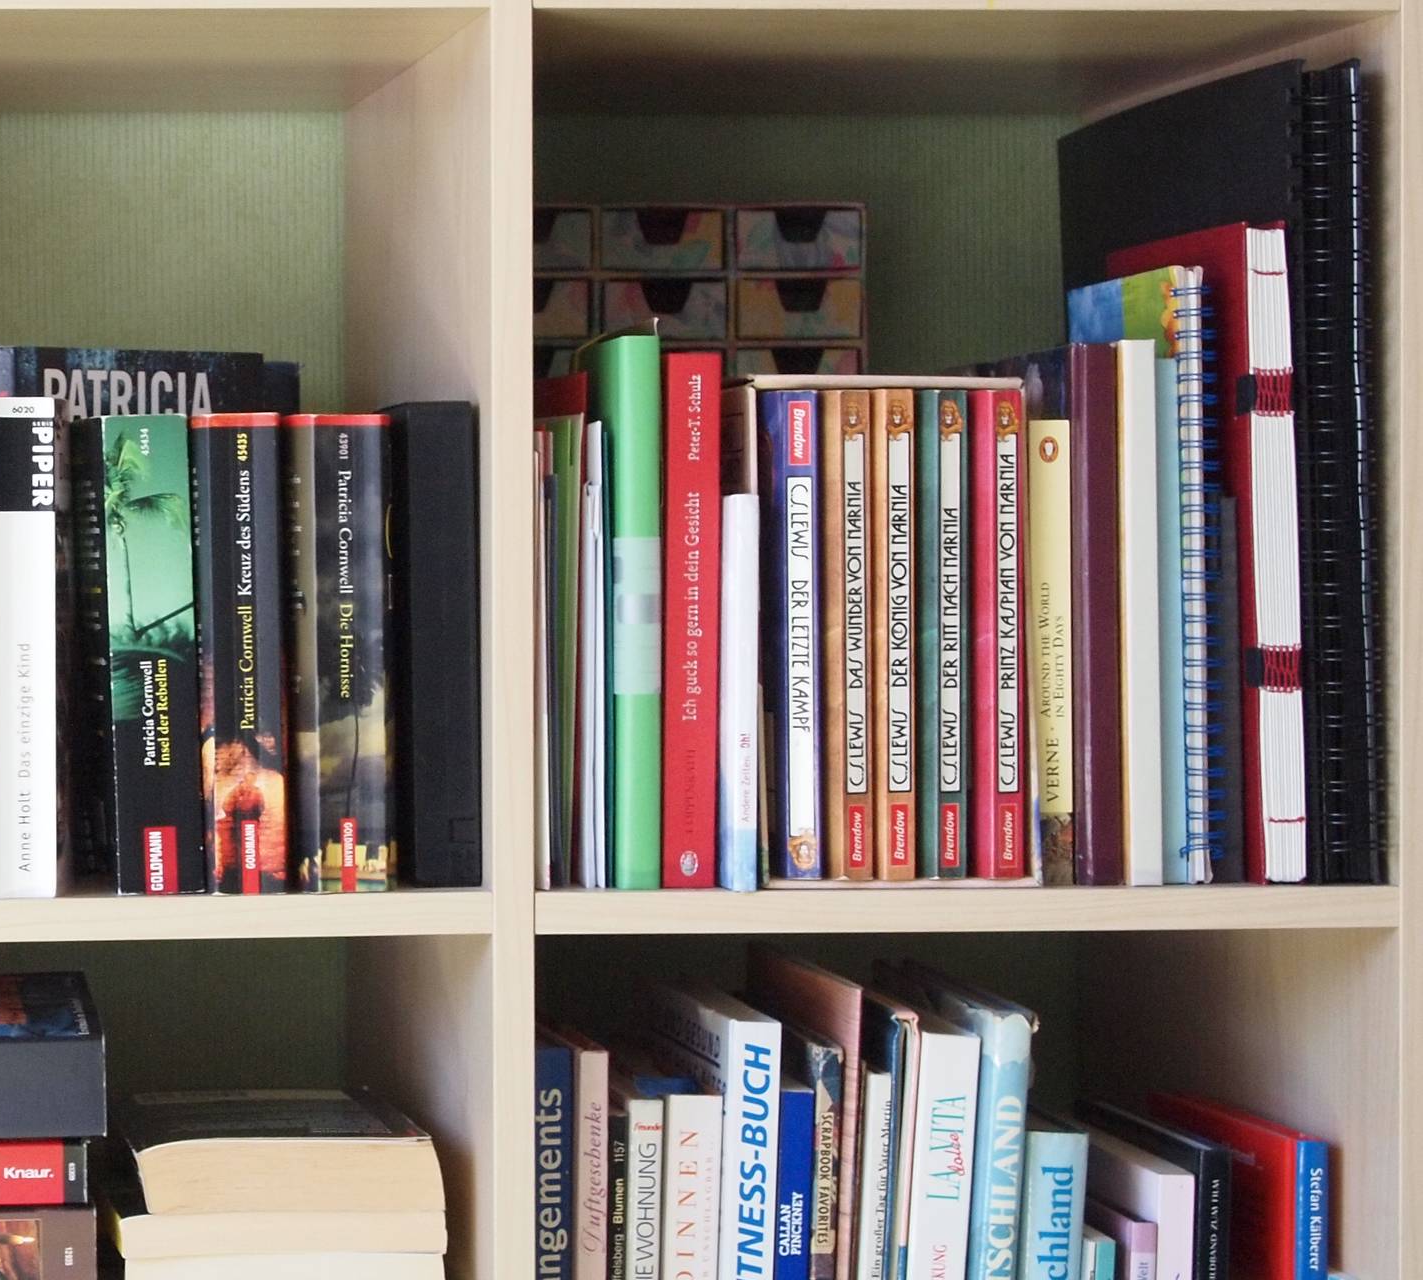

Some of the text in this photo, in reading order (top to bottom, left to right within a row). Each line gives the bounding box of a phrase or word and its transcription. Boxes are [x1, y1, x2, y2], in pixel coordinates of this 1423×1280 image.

[43, 368, 213, 417] PATRICIA
[688, 373, 702, 413] Schulz
[792, 408, 806, 460] Brendow
[31, 426, 54, 508] PIPER
[891, 483, 908, 546] NARNIA
[235, 469, 255, 731] Patricia Cornwell Kreuz des Südens
[337, 470, 354, 699] Patricia Cornwell Die Hornisse
[846, 480, 864, 690] DAS WUNDER VON NARNIA
[891, 550, 908, 591] VON
[1000, 452, 1017, 690] PRINZ KASPIAN VON NARNIA
[681, 491, 702, 722] Ich guck so gern in dein Gesicht
[791, 579, 811, 733] DER LETZTE KAMPF
[891, 656, 908, 689] DER
[139, 660, 157, 767] Patricia Cornwell
[154, 658, 171, 767] Insel der Rebellen
[17, 643, 34, 873] Anne Holt Das einzige Kind
[1046, 737, 1060, 803] VERNE
[148, 830, 164, 892] GOLDMANN
[245, 823, 256, 870] GOLDMANN
[343, 821, 354, 868] GOLDMANN
[852, 810, 865, 863] Brendow
[880, 1100, 892, 1137] Martin
[929, 1095, 966, 1151] VITA
[3, 1166, 54, 1180] Knaur.
[613, 1140, 625, 1163] 1157
[736, 1043, 771, 1280] TNESS-BUCH
[816, 1113, 834, 1245] SCRAPBOOK FAVORITES
[878, 1148, 890, 1174] Vater
[535, 1087, 568, 1280] ngements
[612, 1178, 625, 1225] Blumen
[876, 1194, 887, 1216] Tag
[778, 1203, 792, 1256] CALLAN
[790, 1191, 804, 1256] PINCKNEY
[1308, 1167, 1323, 1272] Stefan Kälberer
